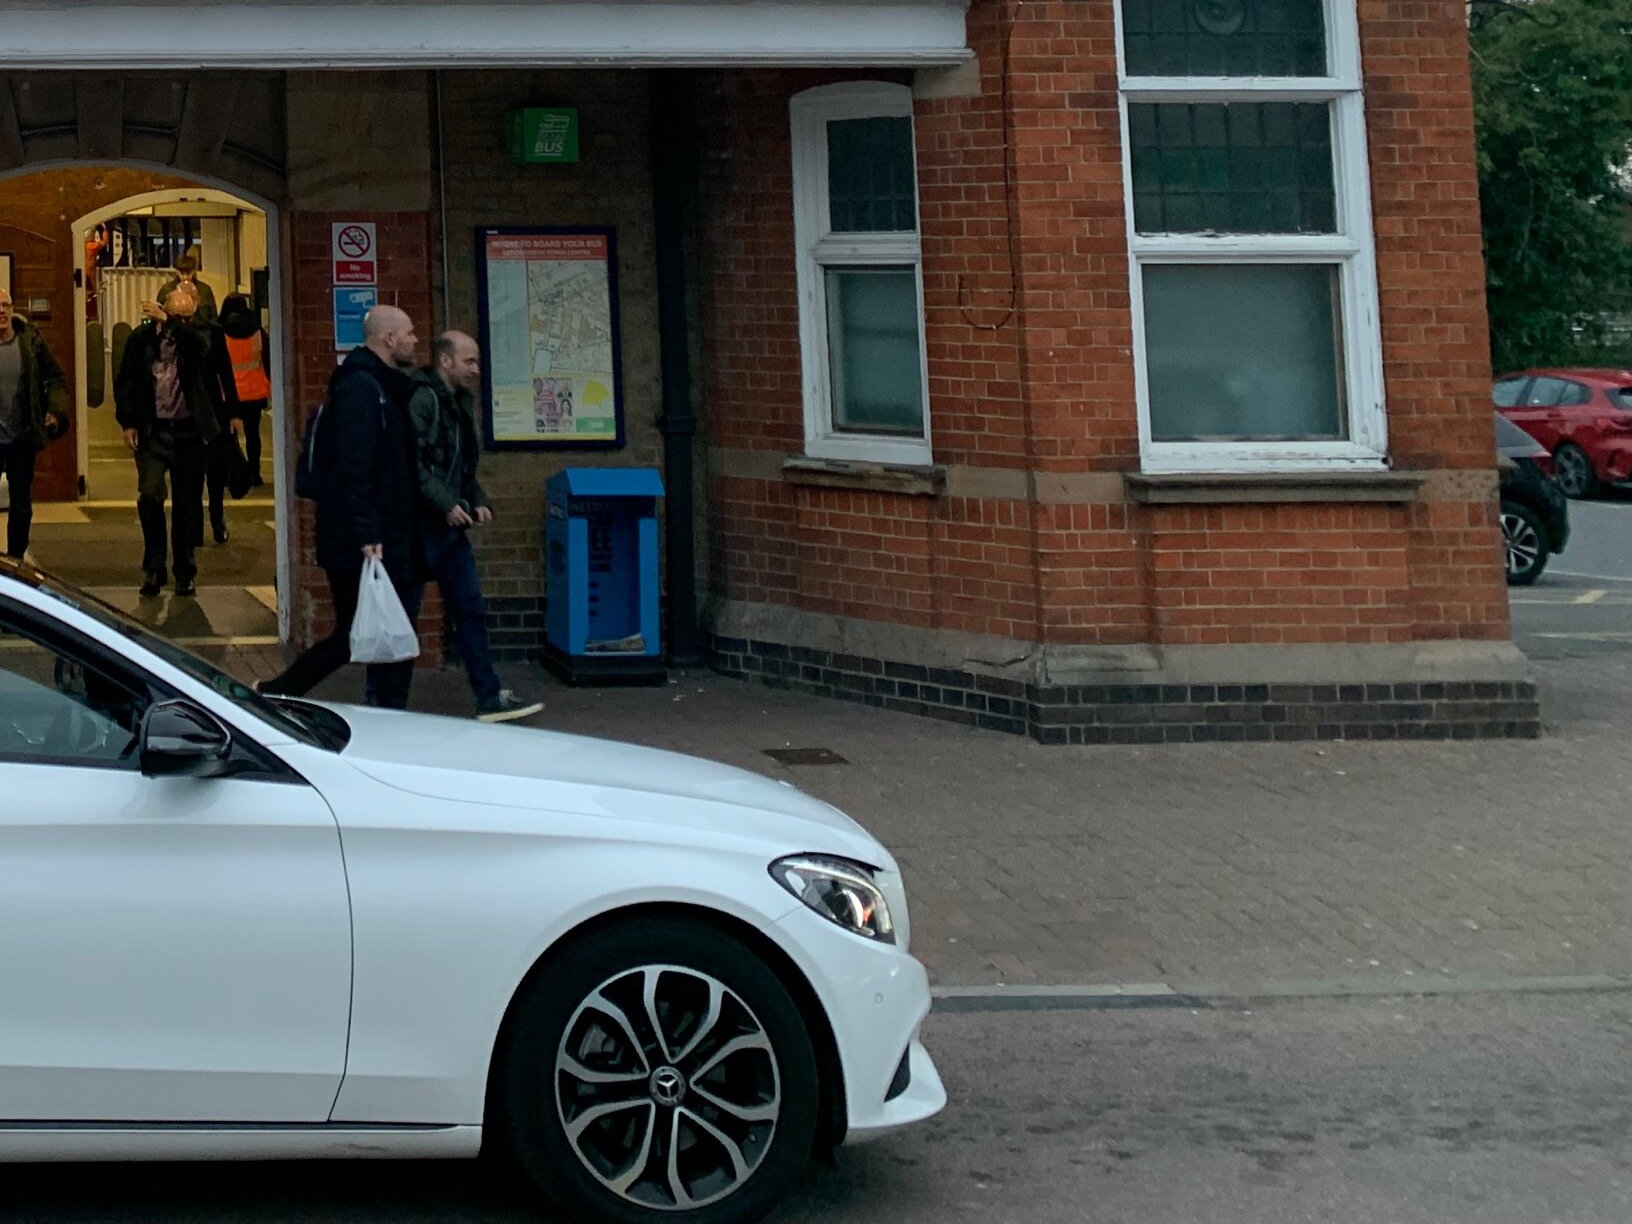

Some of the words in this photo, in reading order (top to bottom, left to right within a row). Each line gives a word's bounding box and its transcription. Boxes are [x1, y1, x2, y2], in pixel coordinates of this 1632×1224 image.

[534, 141, 564, 152] BUS
[520, 240, 531, 248] TO
[533, 240, 561, 248] BOARD
[562, 239, 585, 248] YOUR
[350, 263, 361, 271] No
[339, 272, 371, 281] smoking
